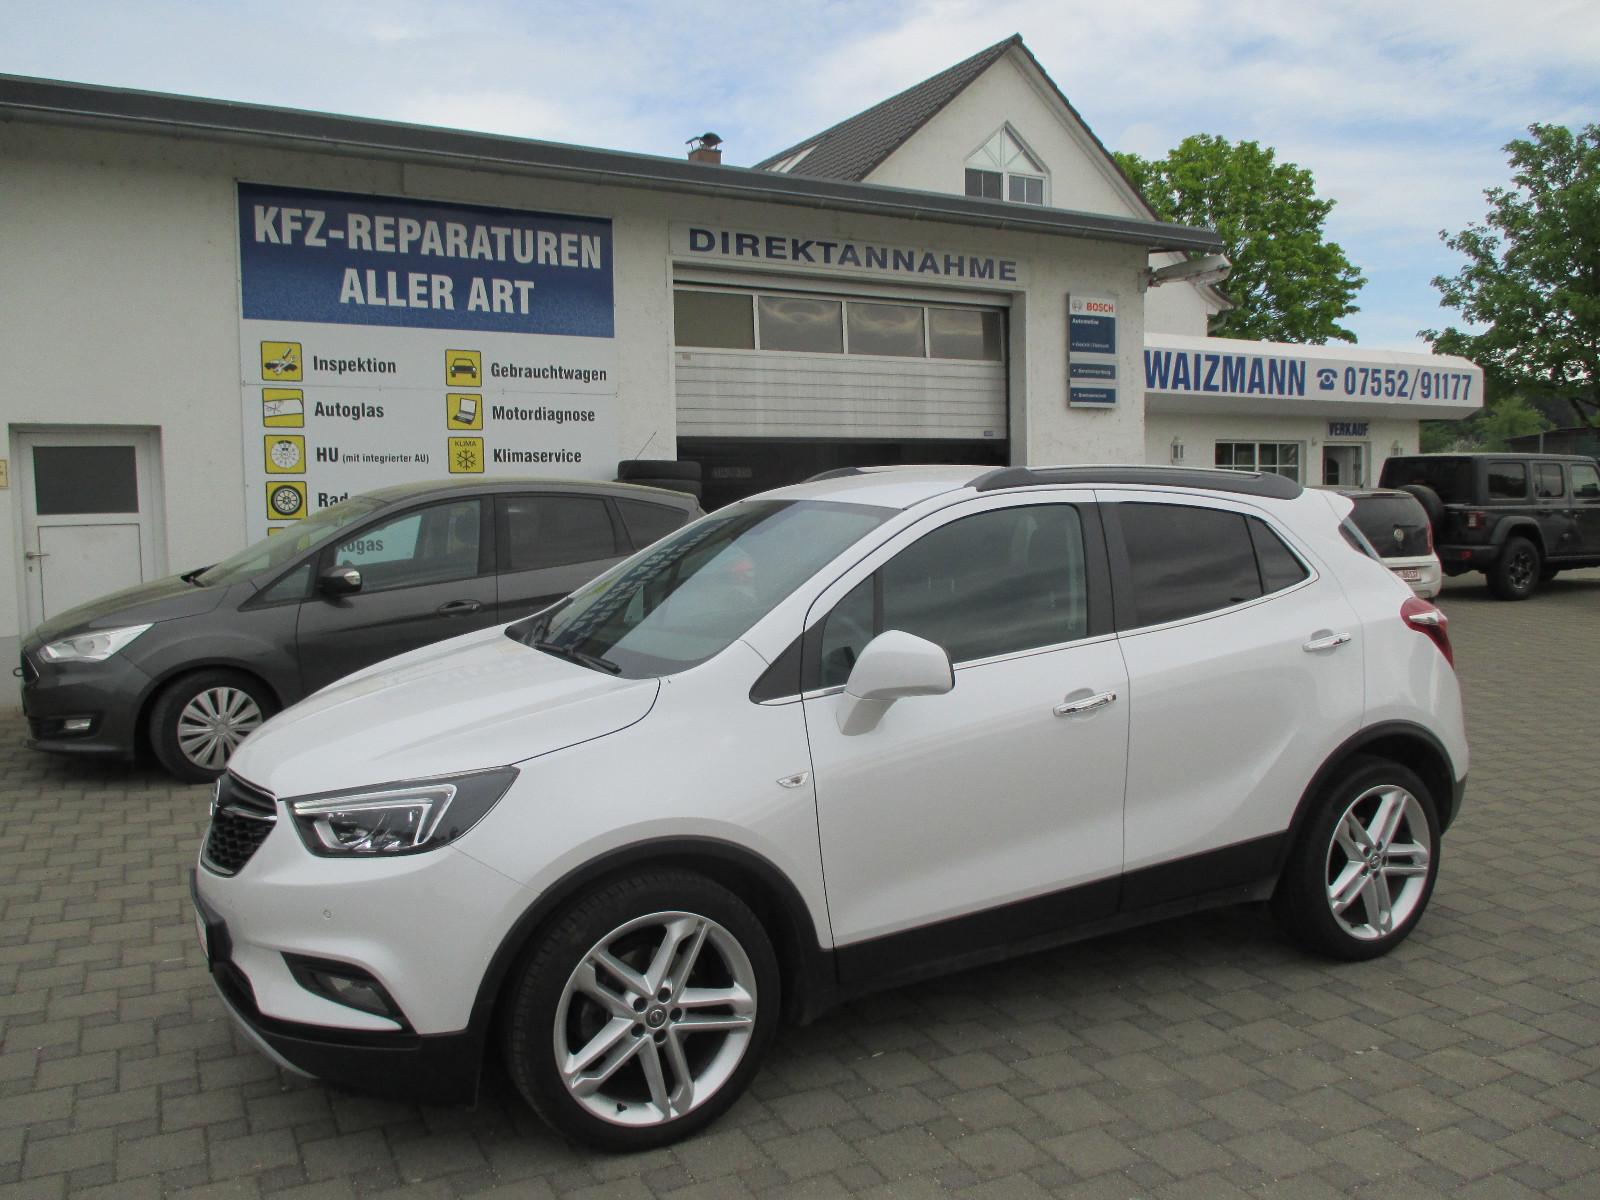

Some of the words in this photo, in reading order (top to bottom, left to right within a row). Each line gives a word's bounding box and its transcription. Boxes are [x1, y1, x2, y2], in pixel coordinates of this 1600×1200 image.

[253, 205, 601, 269] KFZ-REPARATUREN
[689, 227, 1017, 282] DIREKTANNAHME
[339, 268, 454, 311] ALLER
[467, 277, 534, 315] ART
[1086, 302, 1114, 313] BOSCH
[313, 355, 397, 375] Inspektion
[491, 362, 607, 383] Gebrauchtwagen
[1144, 350, 1306, 396] WAIZMANN
[1344, 366, 1472, 401] 07552/91177
[314, 403, 385, 421] Autoglas
[492, 405, 595, 424] Motordiagnose
[1328, 421, 1369, 437] VERKAUF
[316, 447, 339, 462] HU
[342, 455, 360, 465] (mit
[363, 454, 412, 465] integrierter
[414, 454, 430, 465] AU)
[493, 447, 582, 462] Klimaservice
